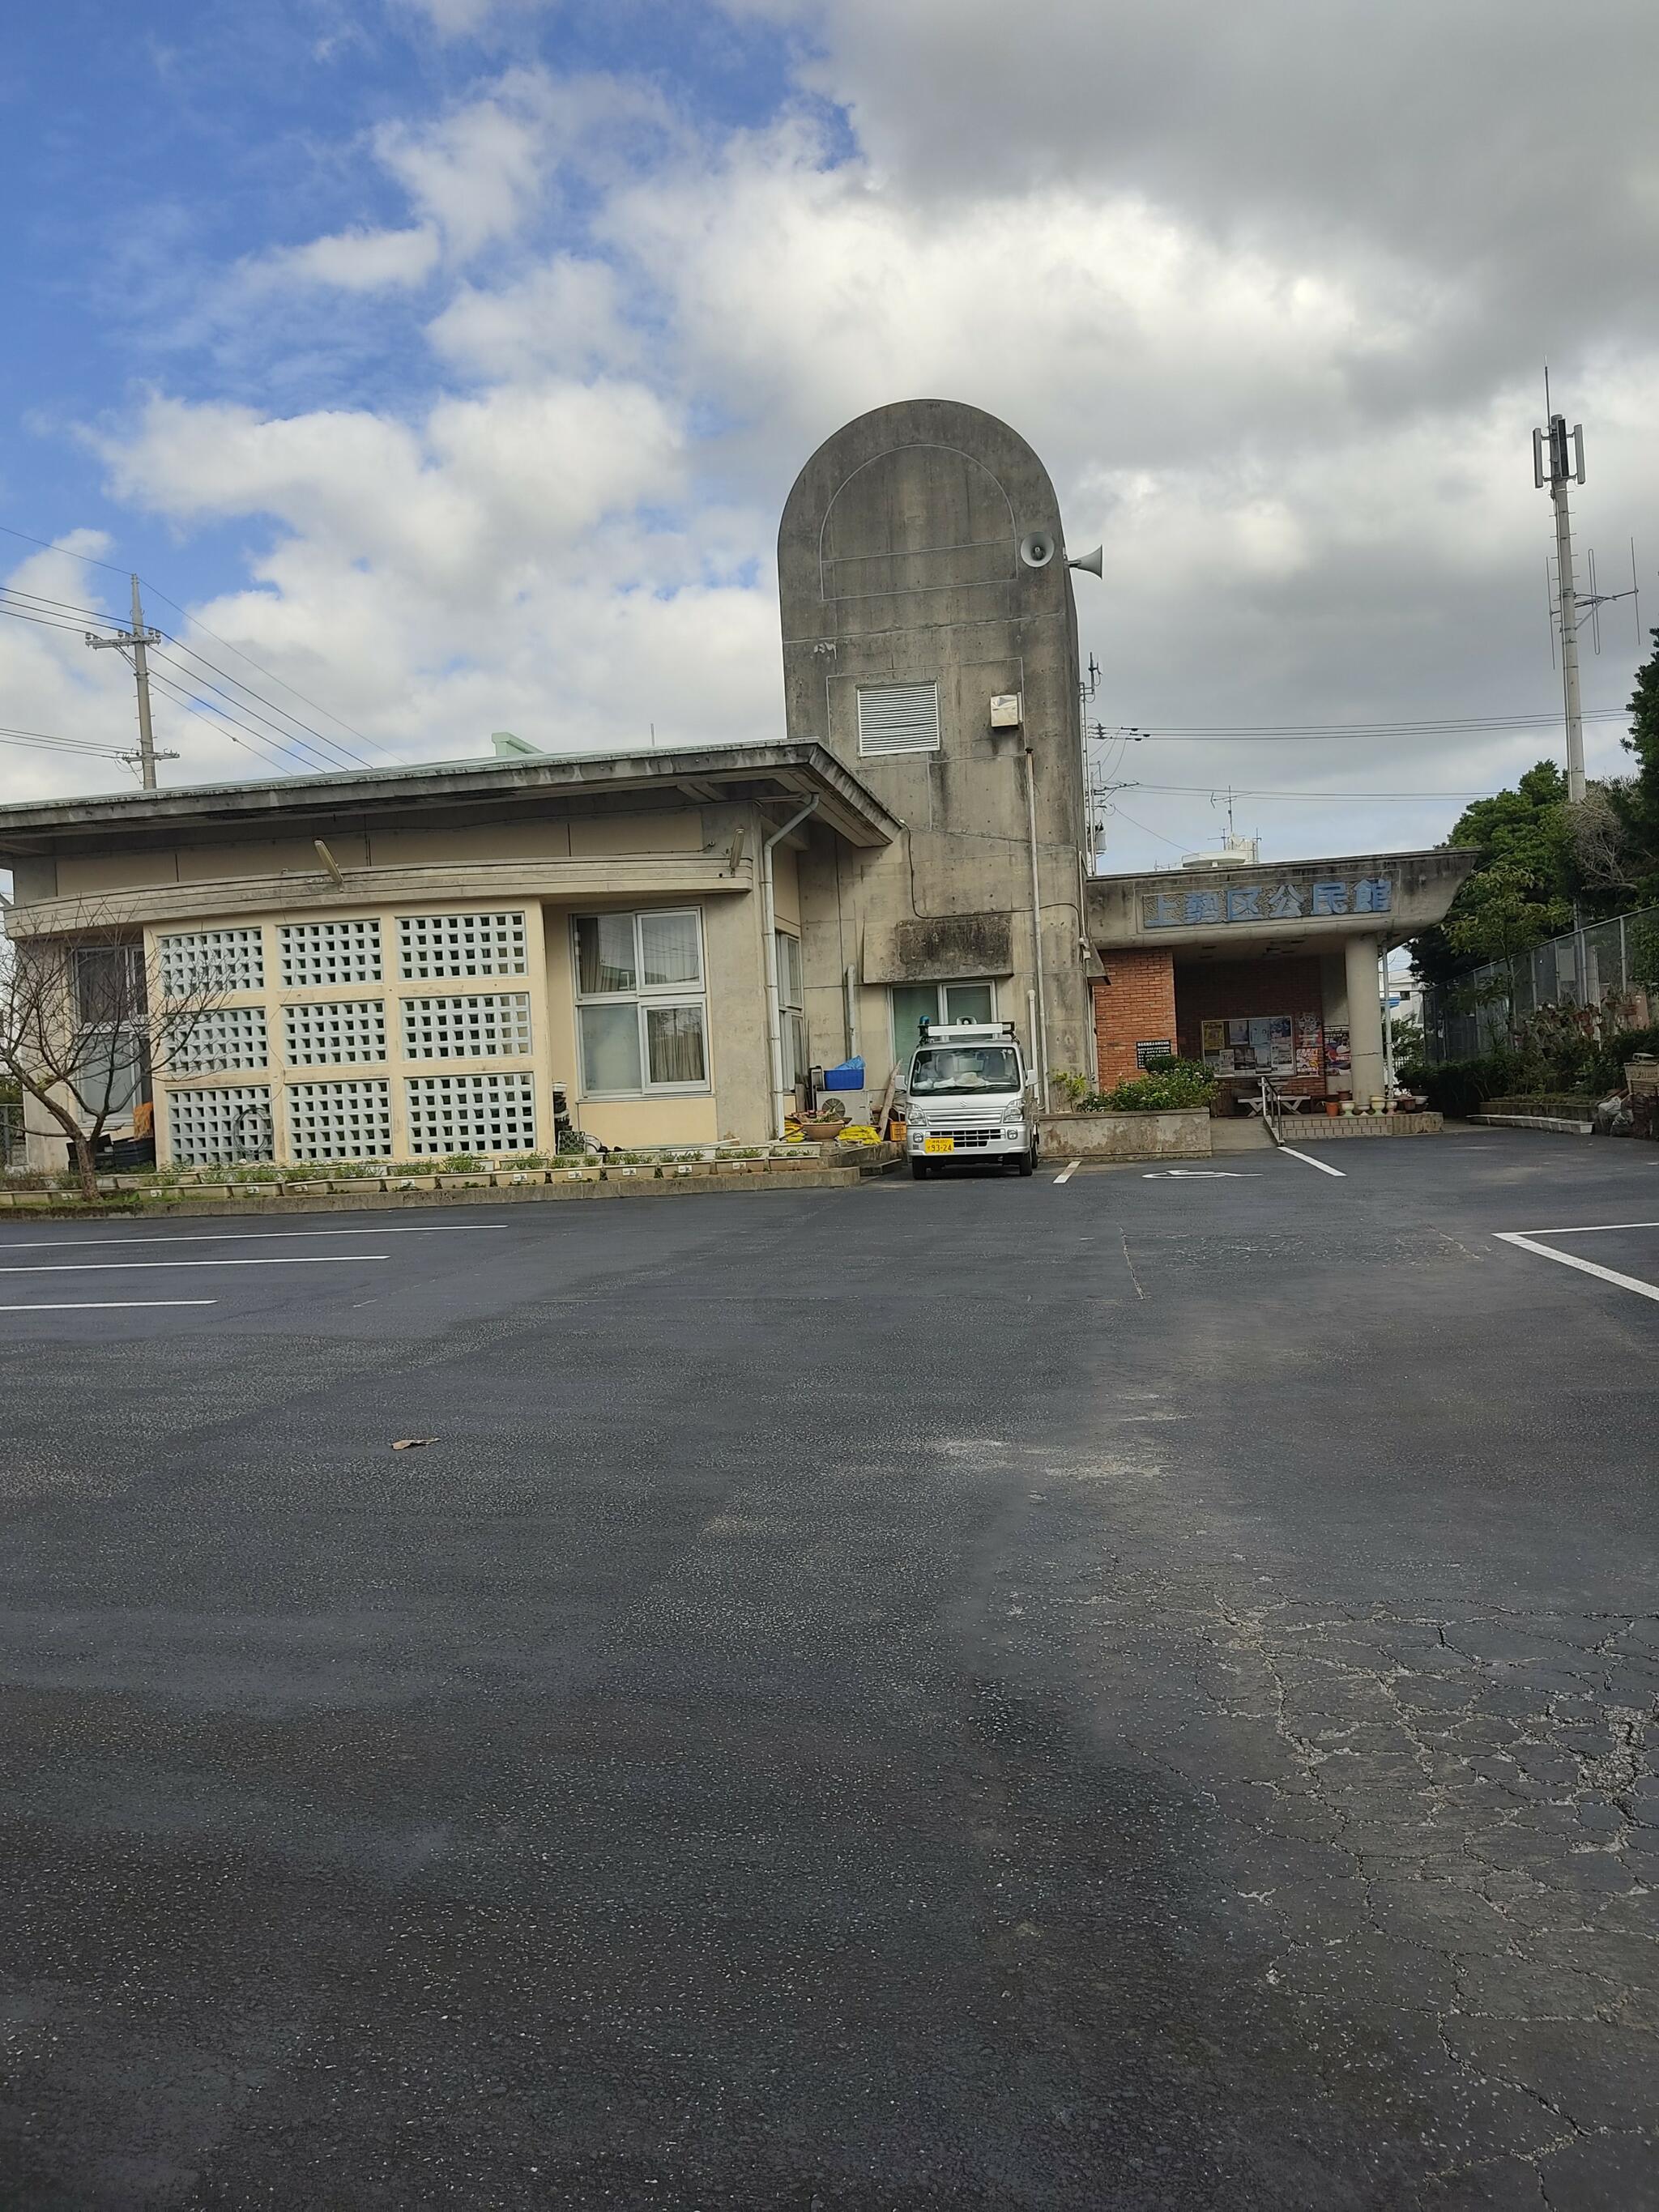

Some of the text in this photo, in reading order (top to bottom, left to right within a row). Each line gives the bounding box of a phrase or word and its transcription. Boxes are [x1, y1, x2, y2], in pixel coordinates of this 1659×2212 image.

[1147, 879, 1392, 926] 上勢区公民館
